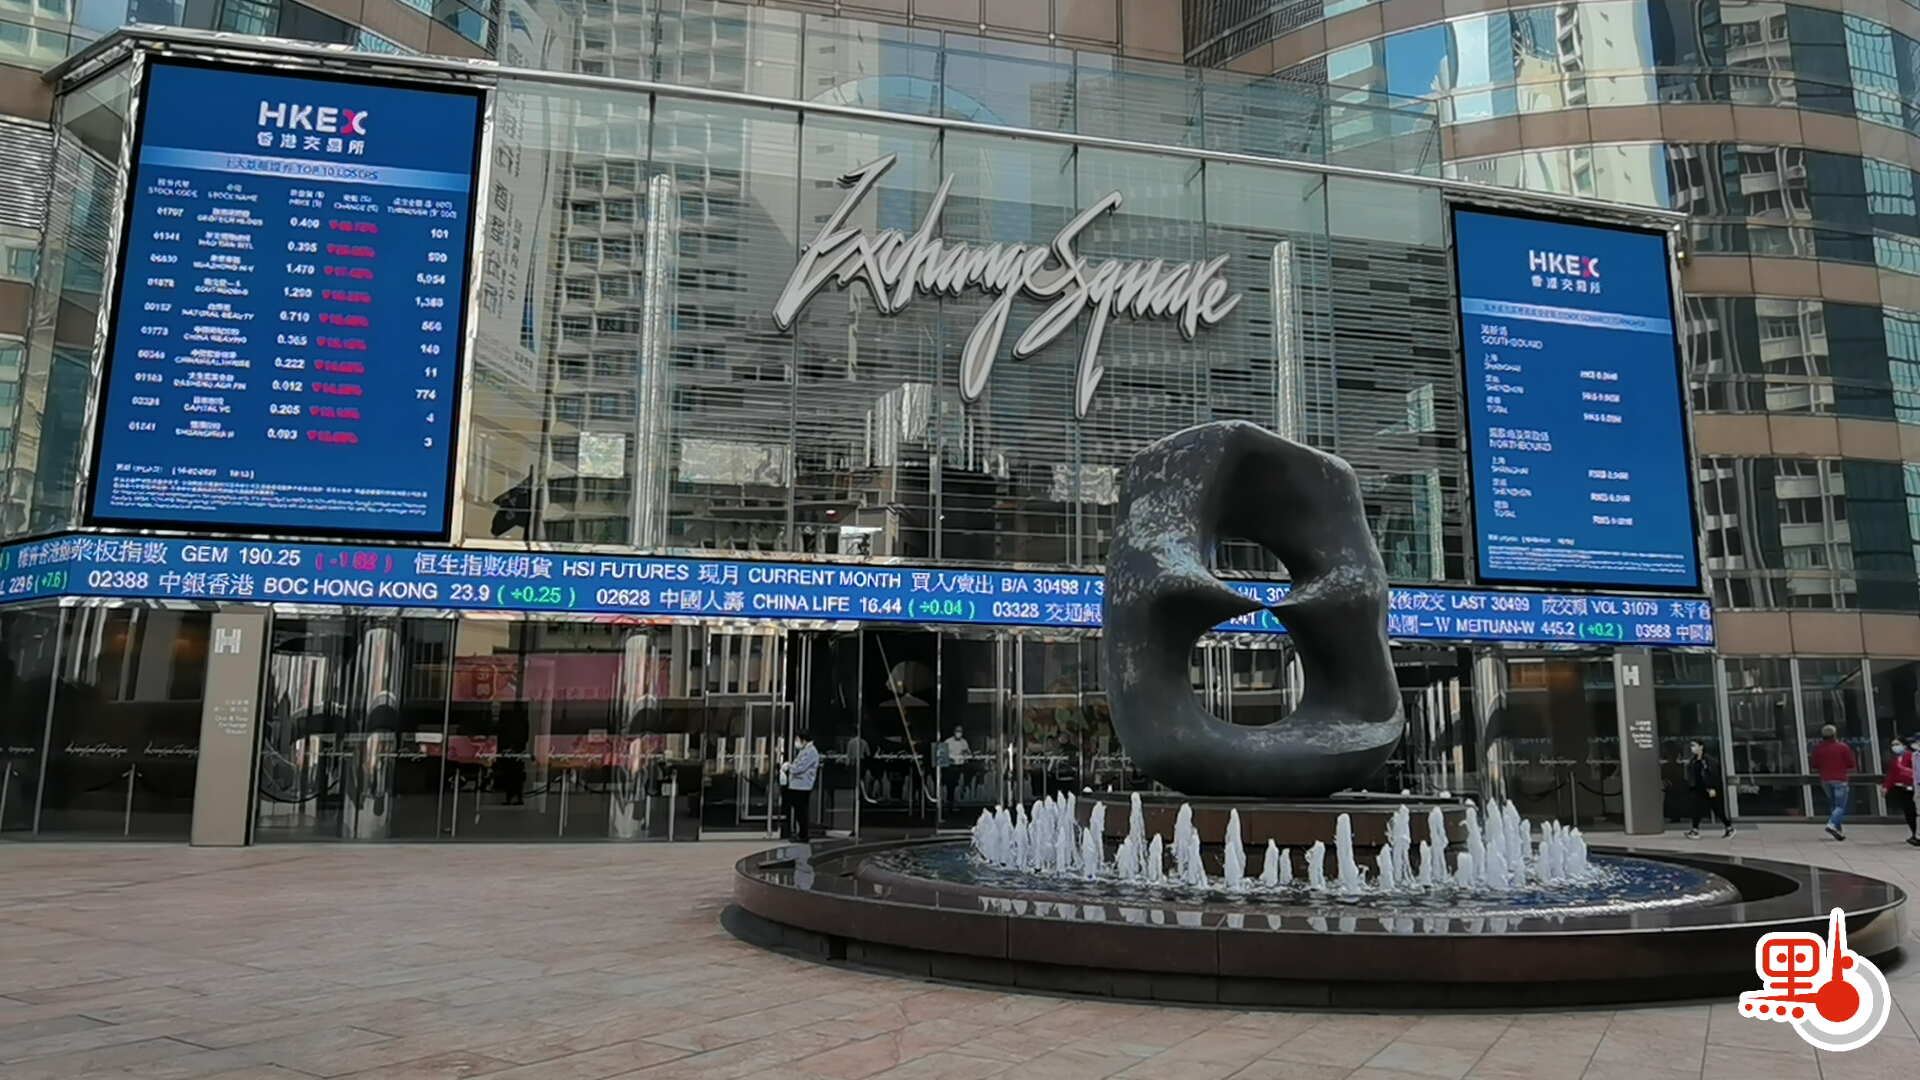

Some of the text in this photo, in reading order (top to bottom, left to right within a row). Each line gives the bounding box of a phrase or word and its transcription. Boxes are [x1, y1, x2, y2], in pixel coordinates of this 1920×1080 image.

[258, 101, 369, 136] HKEX
[257, 131, 366, 156] 香港交易所
[431, 228, 449, 239] 101
[286, 263, 315, 275] 1.470
[1528, 249, 1601, 278] HKEX
[772, 152, 1064, 402] Exchange
[1012, 189, 1243, 420] Square
[280, 311, 310, 323] 0.710
[274, 357, 306, 369] 0.222
[424, 367, 438, 378] 11
[272, 380, 303, 392] 0.012
[181, 545, 228, 563] GEM
[239, 548, 301, 567] 190.25
[413, 552, 689, 581] 恒生指數期貨 HSI FUTURES
[88, 570, 149, 588] 02388
[159, 571, 255, 596] 中銀香港
[263, 577, 309, 594] BOC
[313, 579, 374, 598] HONG
[378, 581, 438, 600] KONG
[450, 583, 491, 602] 23.9
[698, 564, 901, 590] 現月 CURRENT MONTH
[1002, 578, 1029, 594] B/A
[1033, 579, 1079, 596] 30498
[596, 588, 650, 606] 02628
[660, 587, 745, 614] 中國人壽
[752, 593, 810, 612] CHINA
[812, 596, 851, 613] LIFE
[859, 597, 902, 615] 16.44
[992, 601, 1041, 619] 03328
[1451, 595, 1487, 610] LAST
[1491, 596, 1531, 612] 30499
[1591, 601, 1618, 615] VOL
[1622, 602, 1659, 616] 31079
[1456, 618, 1536, 635] MEITUAN-W
[1540, 621, 1576, 637] 445.2
